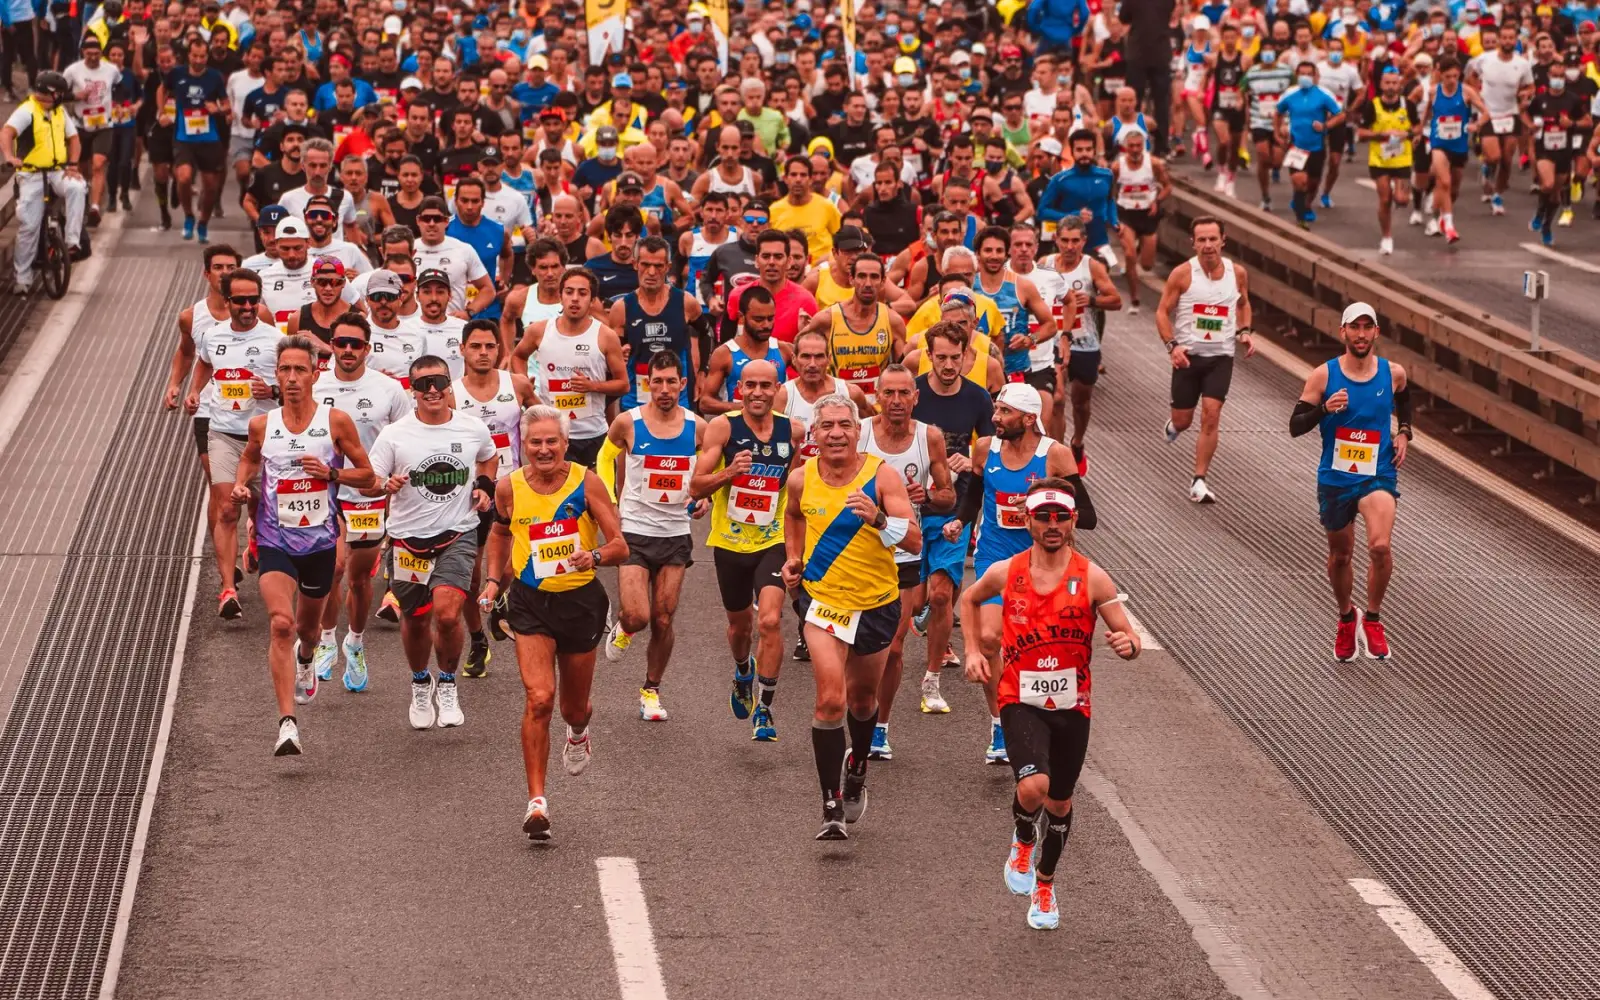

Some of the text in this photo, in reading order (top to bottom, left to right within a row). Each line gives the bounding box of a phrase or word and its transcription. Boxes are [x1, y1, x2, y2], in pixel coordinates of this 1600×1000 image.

[225, 369, 241, 380] edp
[852, 369, 868, 379] edp
[227, 387, 244, 397] 209
[556, 396, 586, 408] 10422
[1349, 430, 1367, 443] edp
[1346, 449, 1365, 460] 178
[420, 455, 460, 470] DIRECTIVO
[659, 457, 678, 470] edp
[292, 480, 312, 493] edp
[655, 478, 677, 488] 456
[748, 476, 767, 490] edp
[424, 491, 457, 501] ULTRAS
[287, 499, 321, 512] 4318
[743, 497, 764, 509] 255
[350, 517, 379, 528] 10421
[544, 523, 564, 537] edp
[539, 543, 575, 559] 10400
[398, 556, 429, 570] 10416
[816, 605, 851, 626] 10410
[1016, 628, 1042, 649] dei
[1036, 655, 1059, 671] edp
[1030, 677, 1069, 693] 4902
